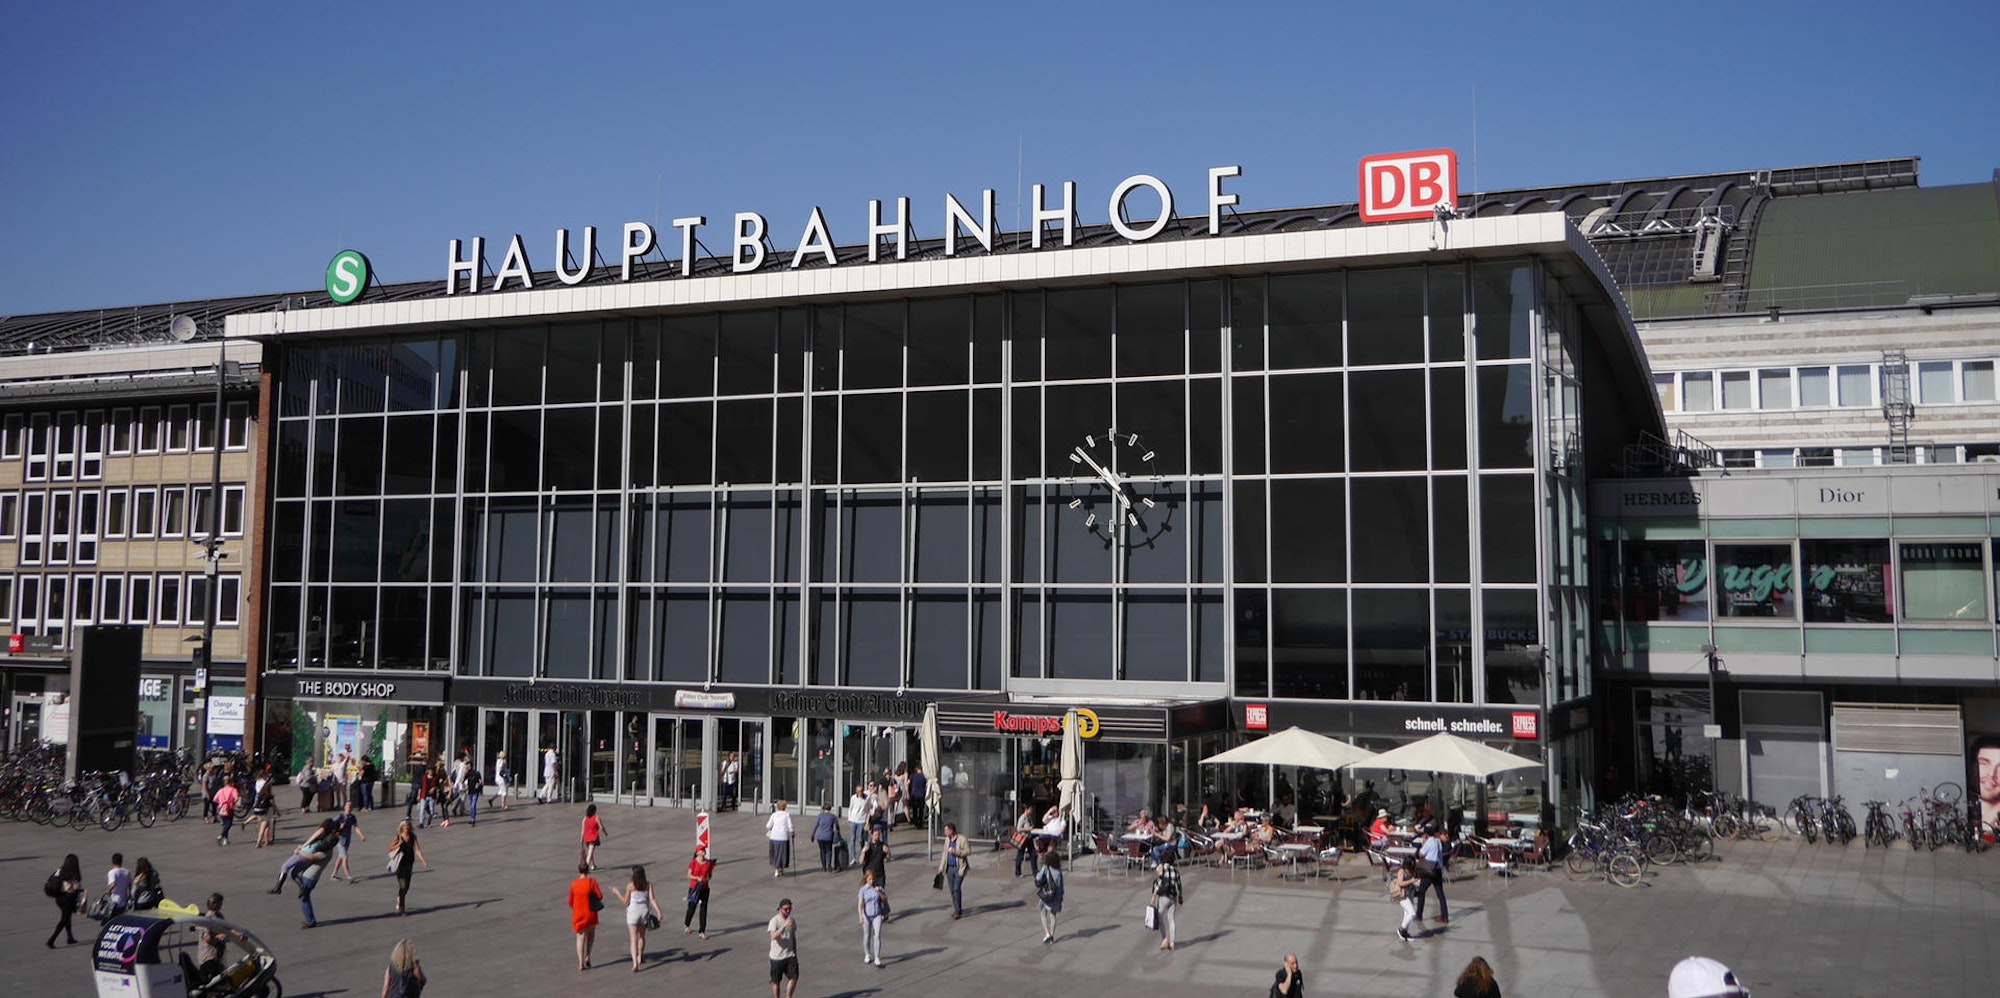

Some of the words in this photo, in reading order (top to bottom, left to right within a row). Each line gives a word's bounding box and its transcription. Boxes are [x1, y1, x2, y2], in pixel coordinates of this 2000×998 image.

[1371, 161, 1443, 210] DB
[446, 164, 1243, 296] HAUPTBAHNHOF
[333, 256, 359, 297] S
[1819, 488, 1865, 504] Dior
[1942, 548, 1979, 559] BROWN
[298, 681, 322, 695] THE
[325, 681, 360, 696] BODY
[361, 683, 395, 697] SHOP
[213, 700, 233, 709] Change
[993, 710, 1060, 735] Kamps
[1246, 708, 1267, 722] EXPRESS
[1513, 715, 1536, 731] EXPRESS
[1405, 717, 1447, 731] schnell.
[1450, 718, 1503, 733] schneller.
